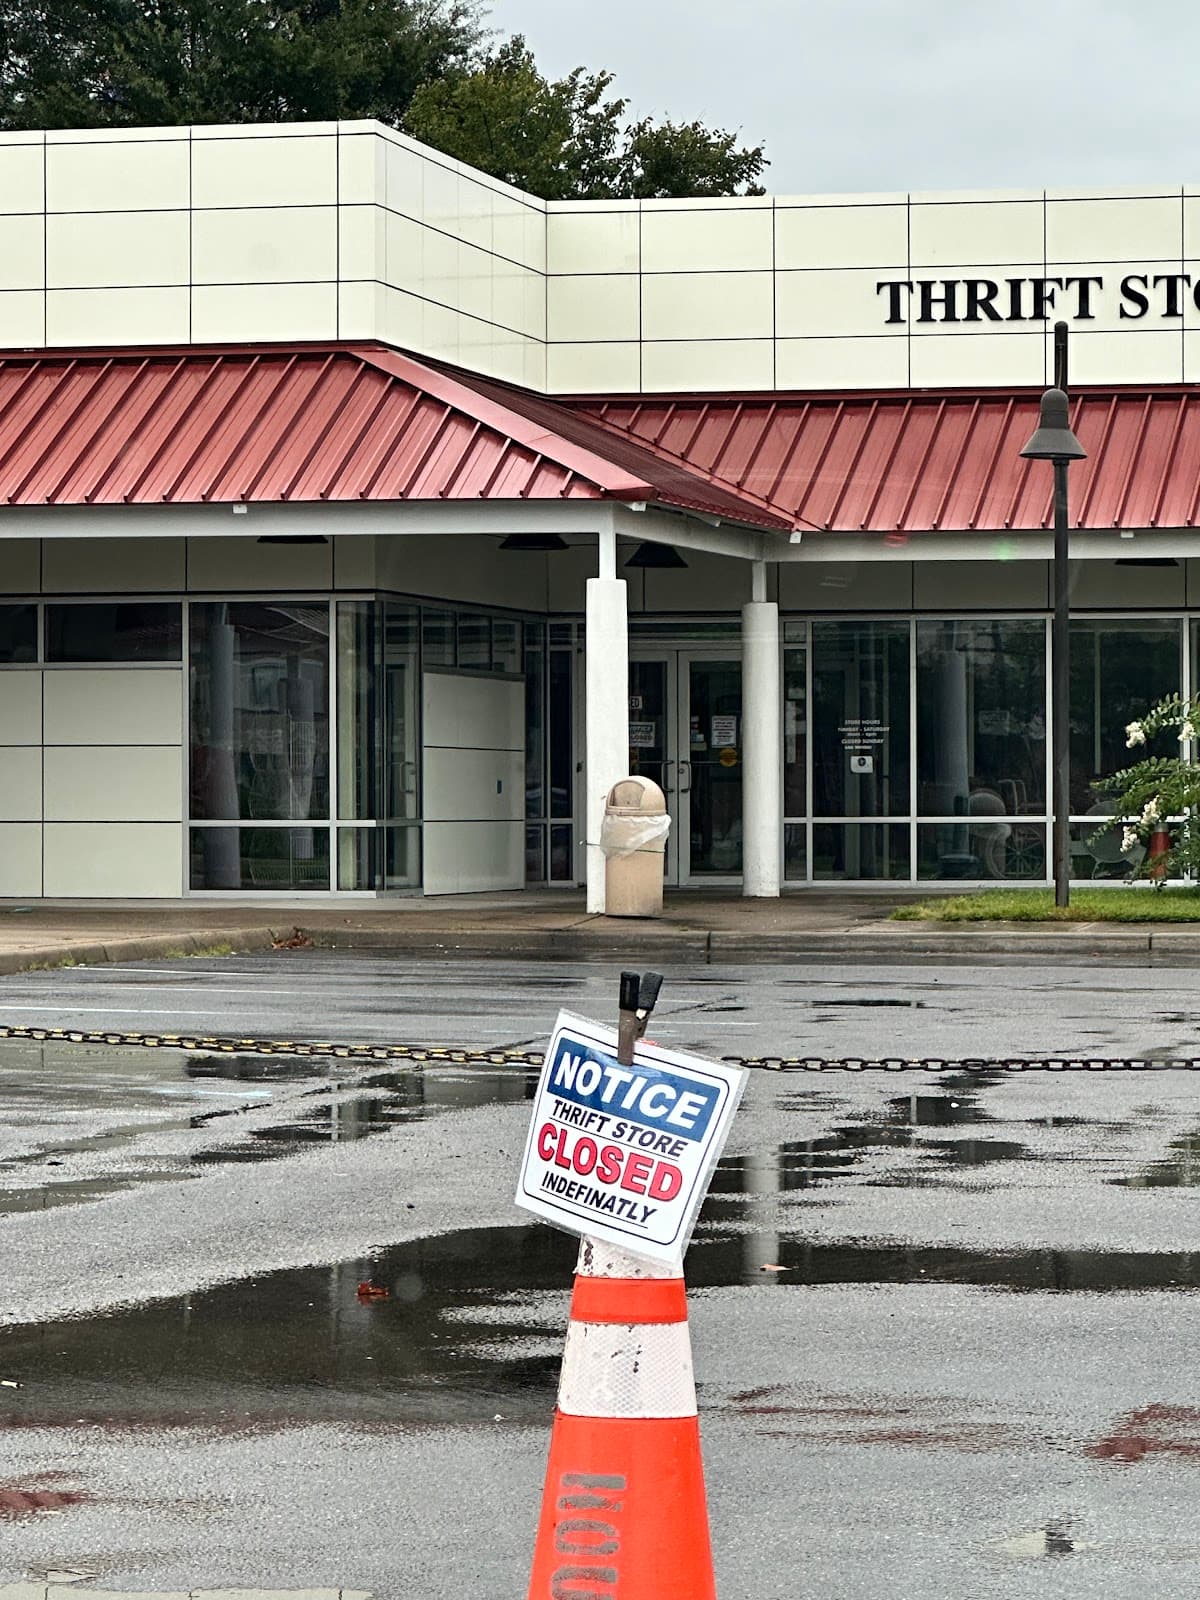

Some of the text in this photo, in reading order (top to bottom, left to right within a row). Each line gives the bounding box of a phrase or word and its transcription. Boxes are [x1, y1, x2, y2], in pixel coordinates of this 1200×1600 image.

[876, 274, 1200, 323] THRIFT ST
[554, 1051, 708, 1130] NOTICE
[551, 1099, 689, 1158] THRIFT STORE
[537, 1122, 683, 1202] CLOSED
[541, 1170, 658, 1223] INDEFINATLY
